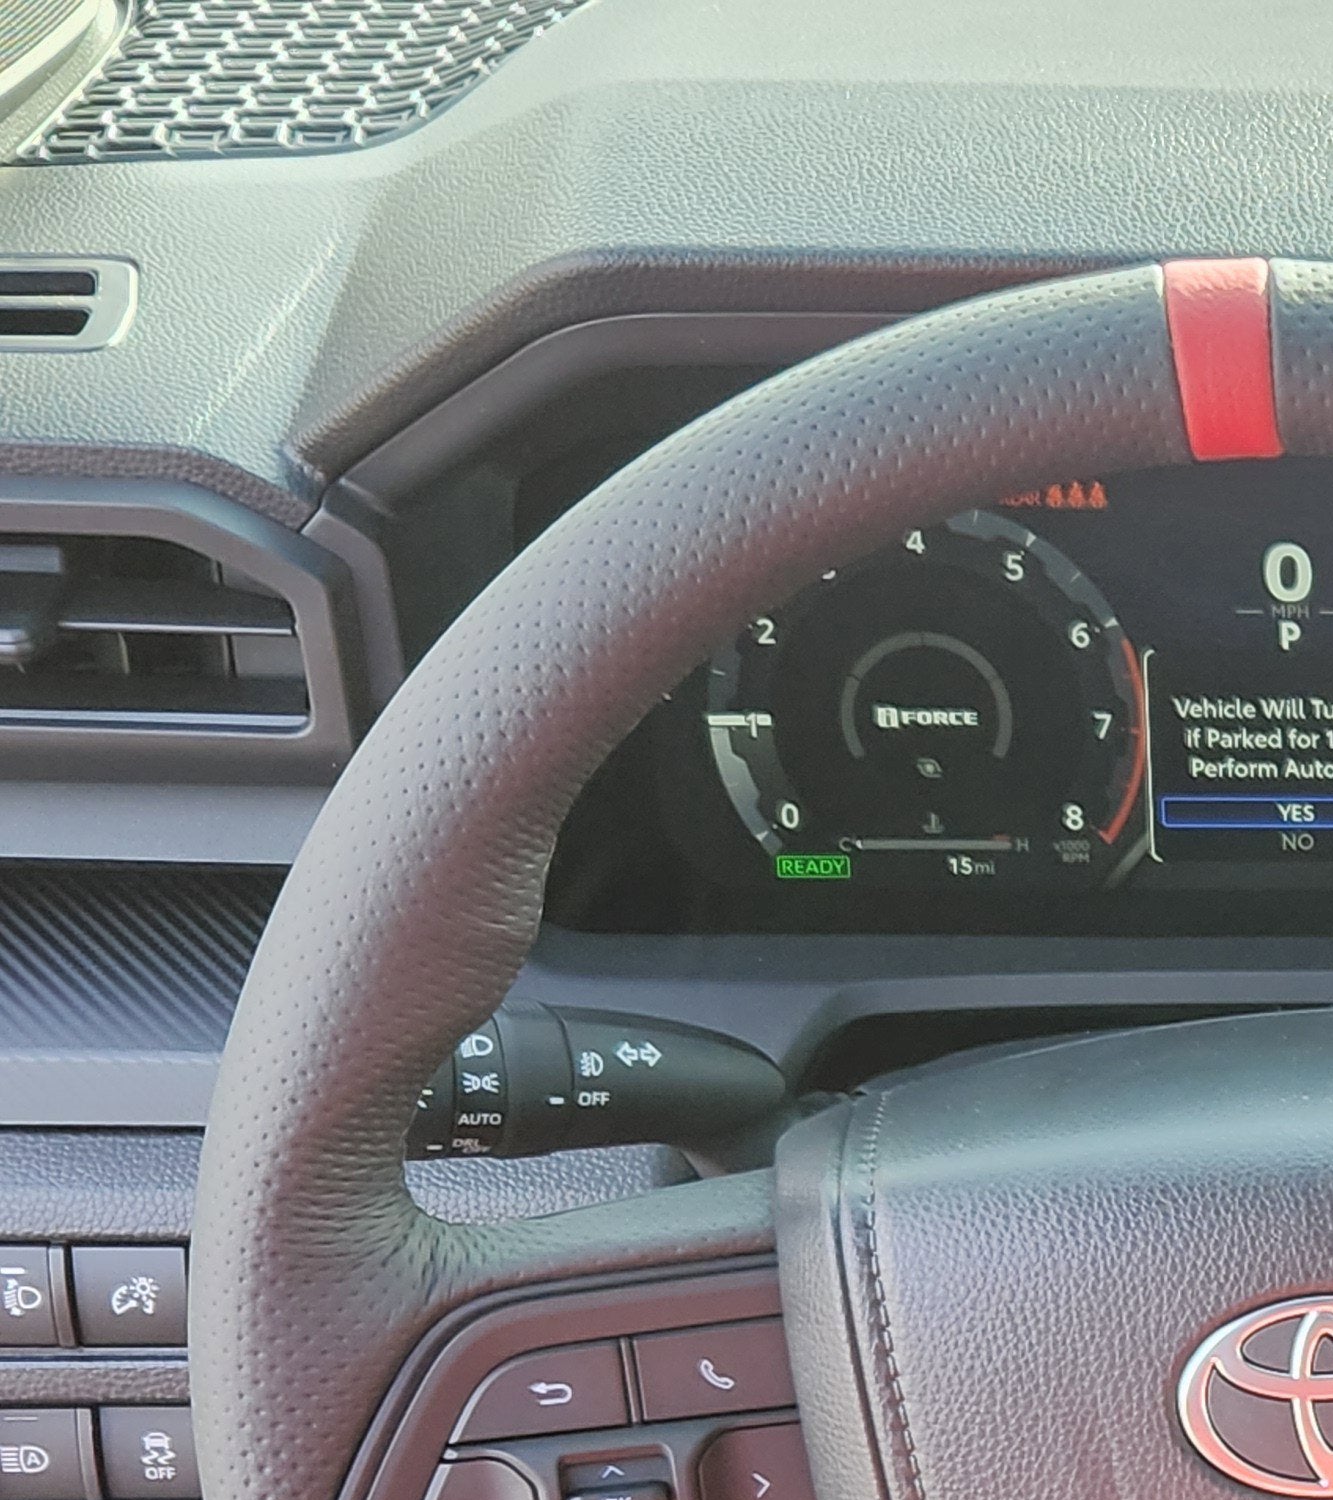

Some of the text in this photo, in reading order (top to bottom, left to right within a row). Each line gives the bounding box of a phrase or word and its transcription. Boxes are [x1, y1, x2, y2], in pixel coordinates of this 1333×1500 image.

[905, 531, 925, 554] 4
[1003, 554, 1024, 581] 5
[1264, 542, 1313, 601] 0
[1271, 604, 1310, 620] MPH
[755, 620, 776, 645] 2
[1069, 624, 1090, 648] 6
[1279, 623, 1300, 649] P
[1173, 697, 1257, 719] Vehicle
[1260, 697, 1306, 719] Will
[1093, 712, 1113, 740] 7
[1186, 729, 1201, 748] if
[1207, 729, 1283, 749] Parked
[1288, 729, 1320, 749] for
[1191, 758, 1279, 779] Perform
[780, 804, 800, 828] 0
[1063, 804, 1084, 831] 8
[1278, 804, 1316, 822] YES
[1016, 838, 1030, 851] H
[1281, 834, 1315, 851] NO
[781, 858, 846, 875] READY
[577, 1092, 611, 1107] OFF
[458, 1112, 503, 1127] AUTO
[145, 1467, 176, 1481] OFF
